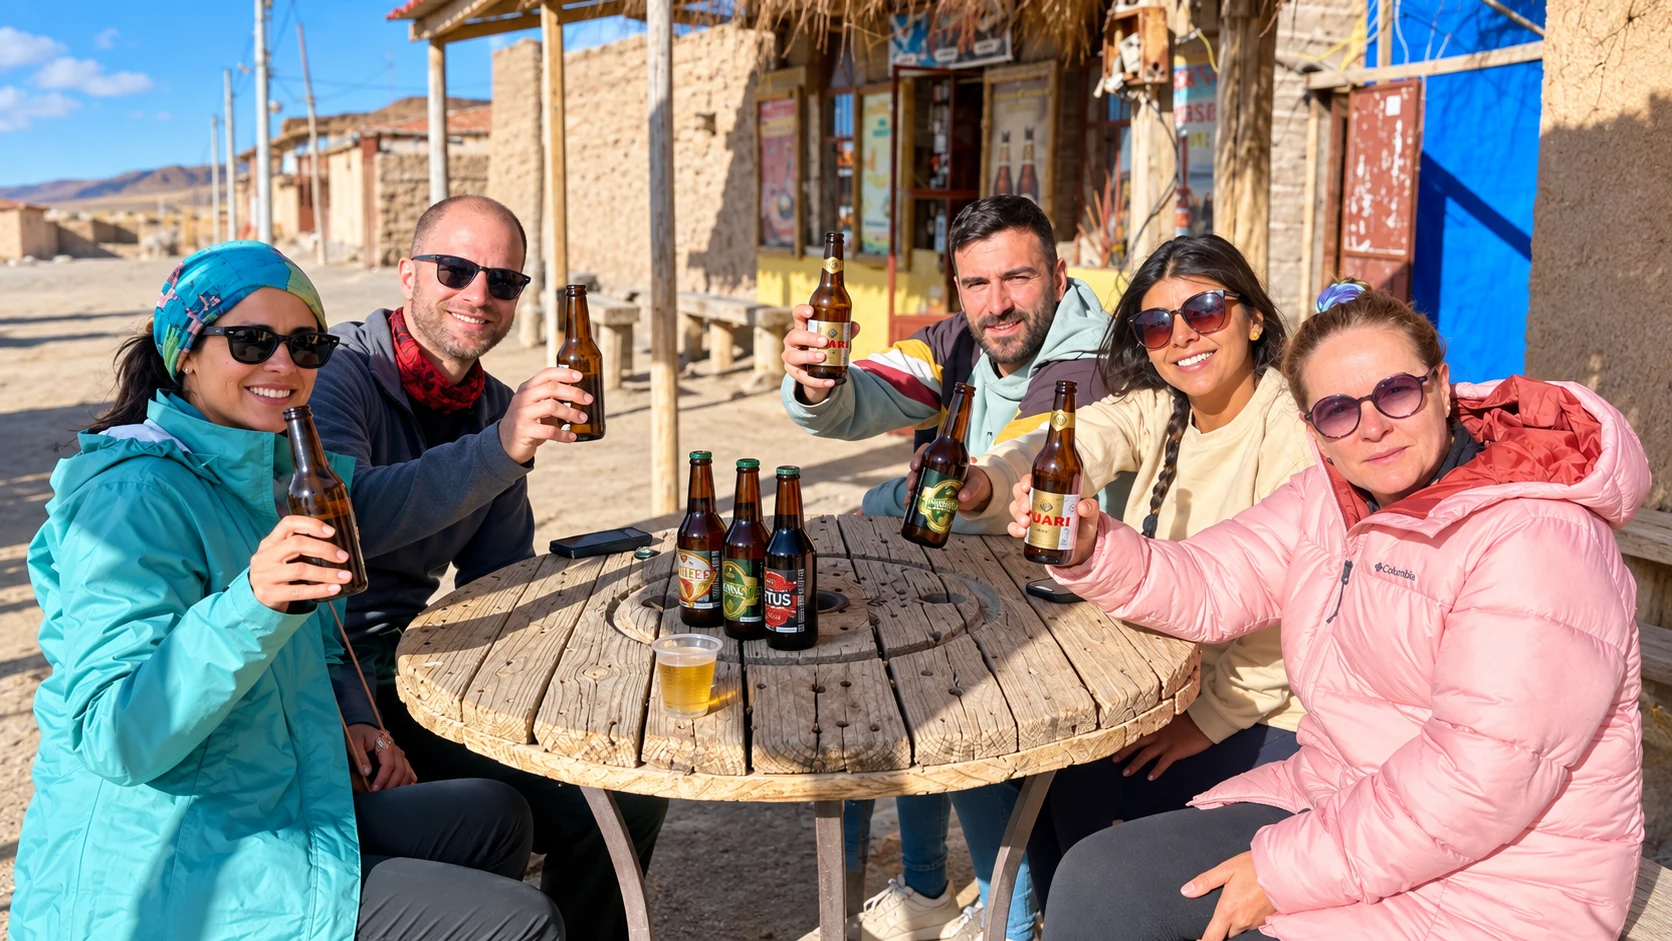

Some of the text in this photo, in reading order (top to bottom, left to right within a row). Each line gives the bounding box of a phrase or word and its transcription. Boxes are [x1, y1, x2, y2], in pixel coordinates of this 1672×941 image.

[827, 339, 848, 349] ARI
[1031, 511, 1071, 527] UARI
[1382, 564, 1416, 581] Columbia
